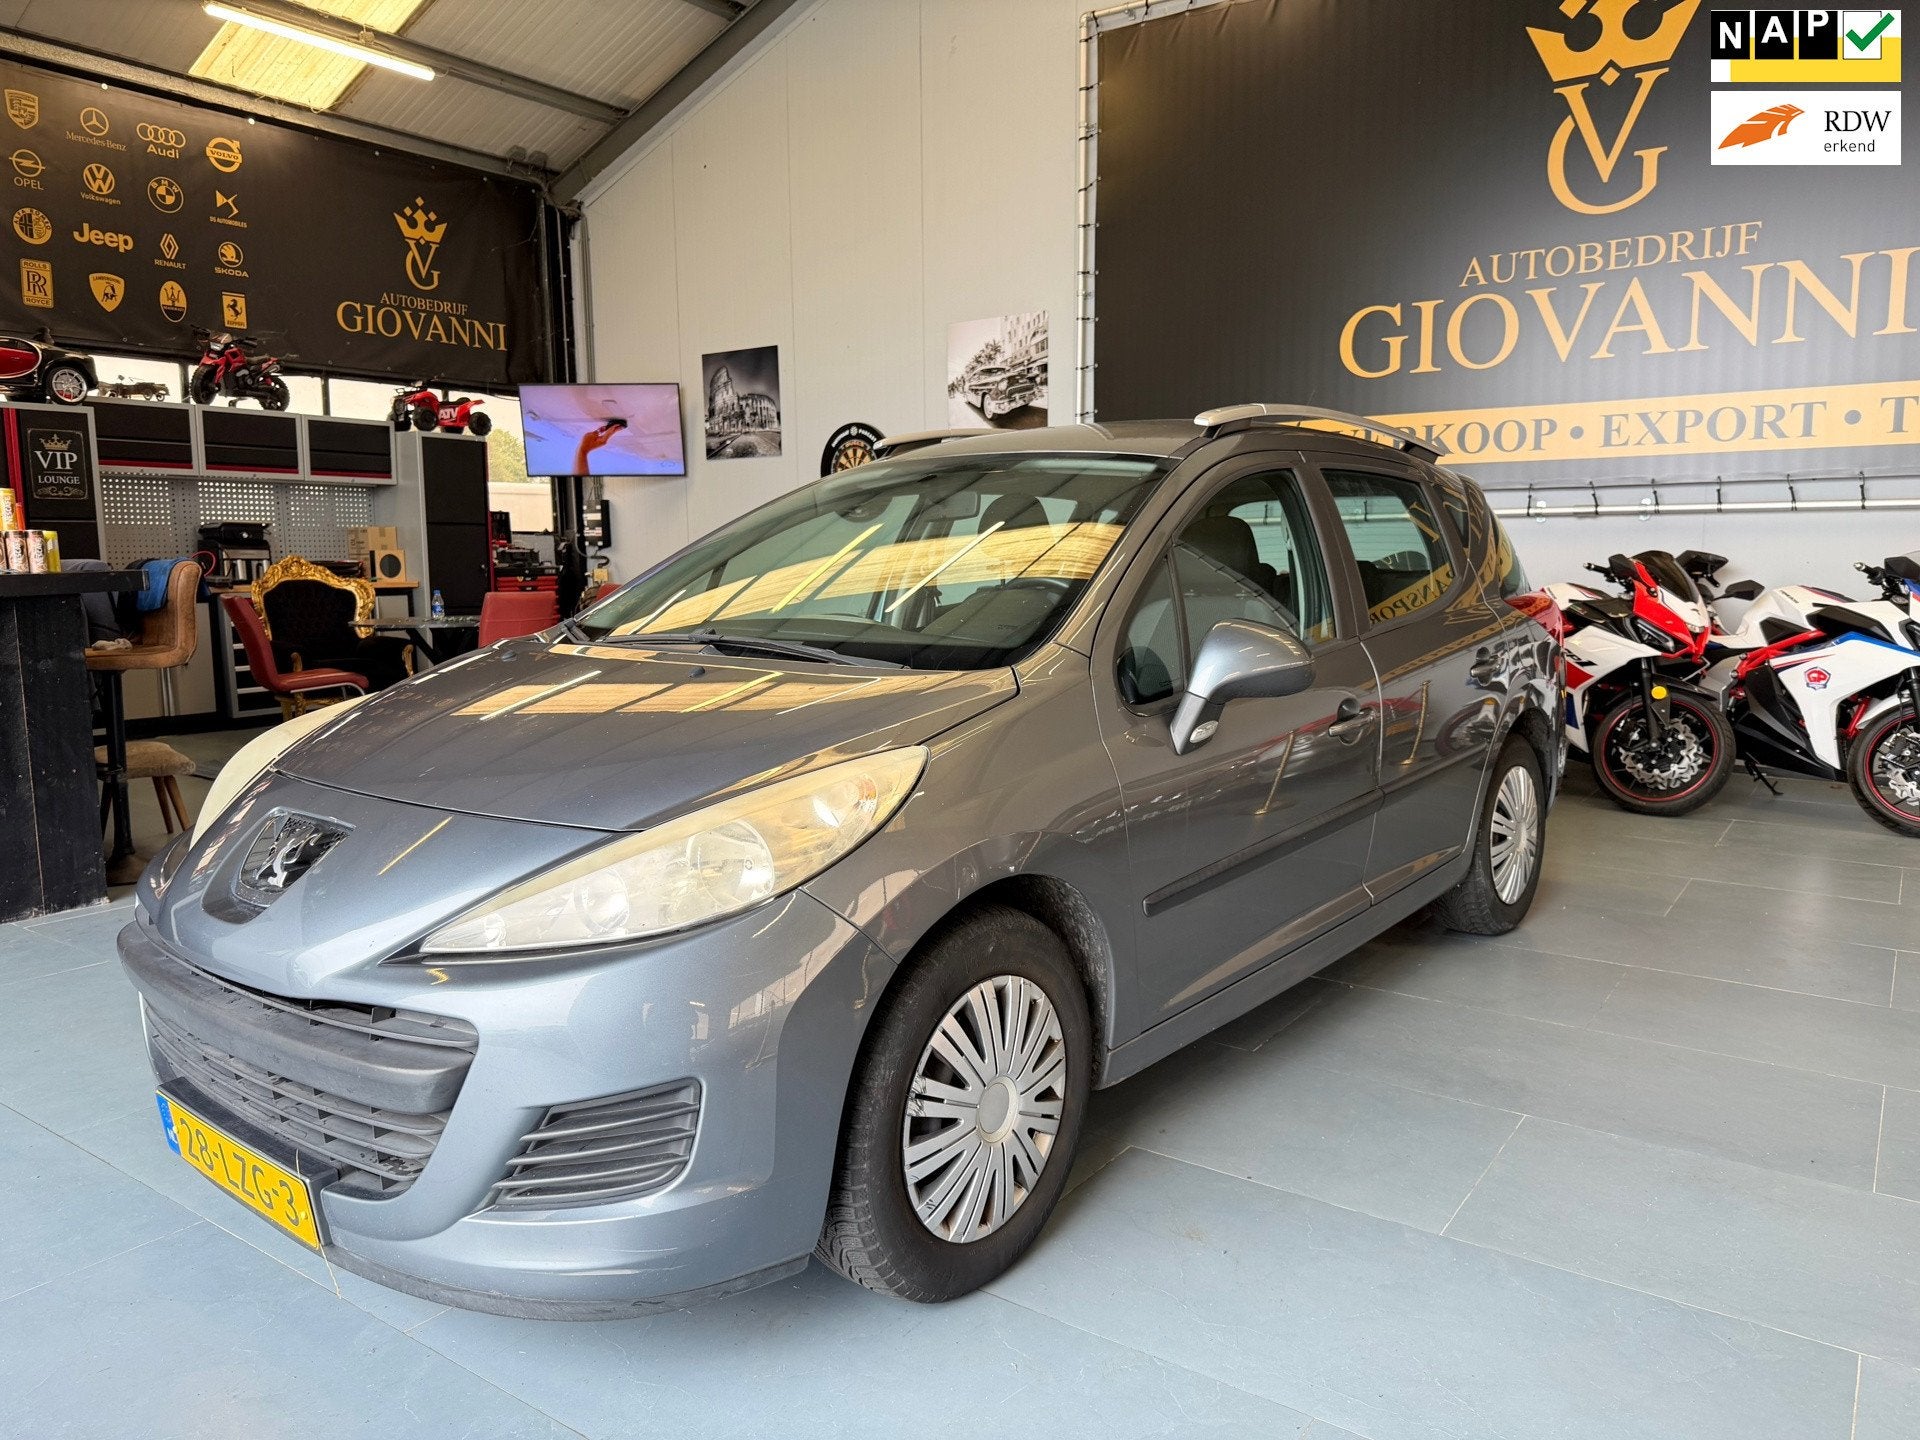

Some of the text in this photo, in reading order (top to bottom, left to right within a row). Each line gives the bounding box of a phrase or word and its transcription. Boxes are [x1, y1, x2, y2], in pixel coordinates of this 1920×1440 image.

[146, 144, 179, 159] Audi
[210, 149, 239, 160] VOLVO
[13, 176, 45, 190] OPEL
[73, 222, 134, 253] Jeep
[154, 259, 187, 270] RENAULT
[1459, 220, 1763, 288] AUTOBEDRIJF
[380, 292, 469, 316] AUTOBEDRIJF
[1339, 246, 1920, 379] GIOVANNI
[336, 301, 507, 352] GIOVANNI
[438, 407, 459, 420] ATV
[1599, 400, 1827, 449] EXPORT
[34, 450, 78, 470] VIP
[38, 475, 80, 485] LOUNGE
[180, 1117, 300, 1227] 28-LZG-3
